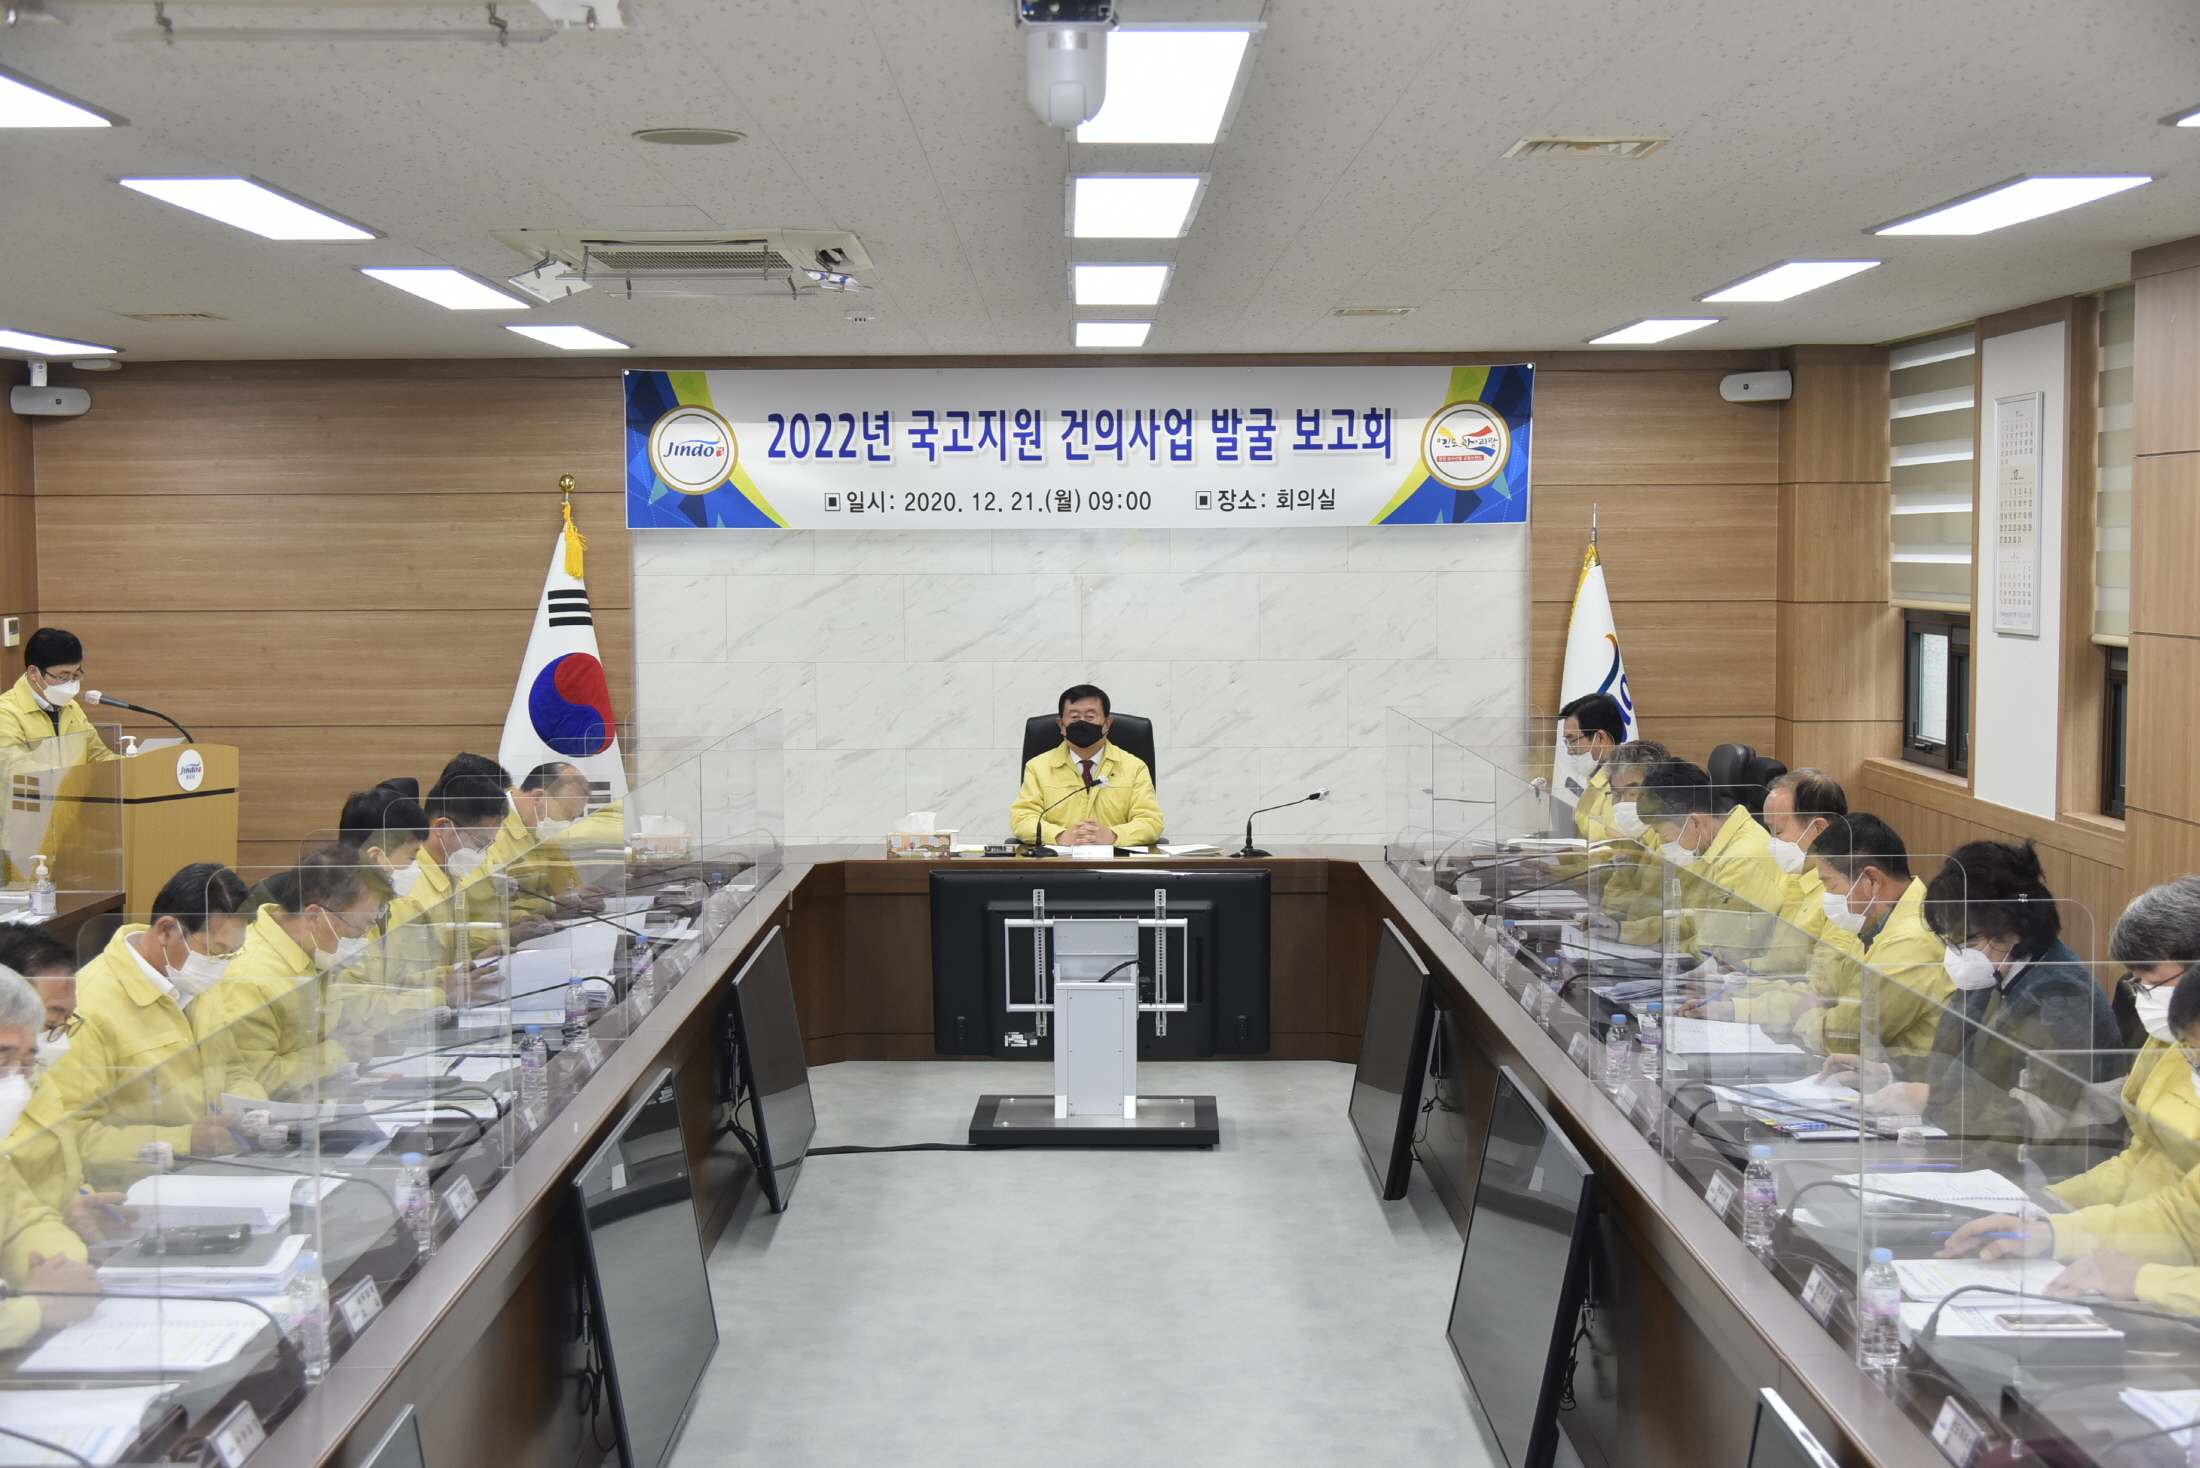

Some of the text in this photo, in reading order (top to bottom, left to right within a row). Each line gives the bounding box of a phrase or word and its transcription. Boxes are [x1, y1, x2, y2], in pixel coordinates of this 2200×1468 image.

[768, 407, 1392, 462] 2022년 국고지원 건의사업 발굴 보고회
[663, 442, 714, 457] Jindo
[846, 491, 895, 513] 일시:
[904, 491, 963, 513] 2020.
[972, 491, 1003, 513] 12.
[1088, 491, 1152, 512] 09:00
[1217, 487, 1336, 512] 장소: 회의실
[179, 766, 198, 775] Jindo
